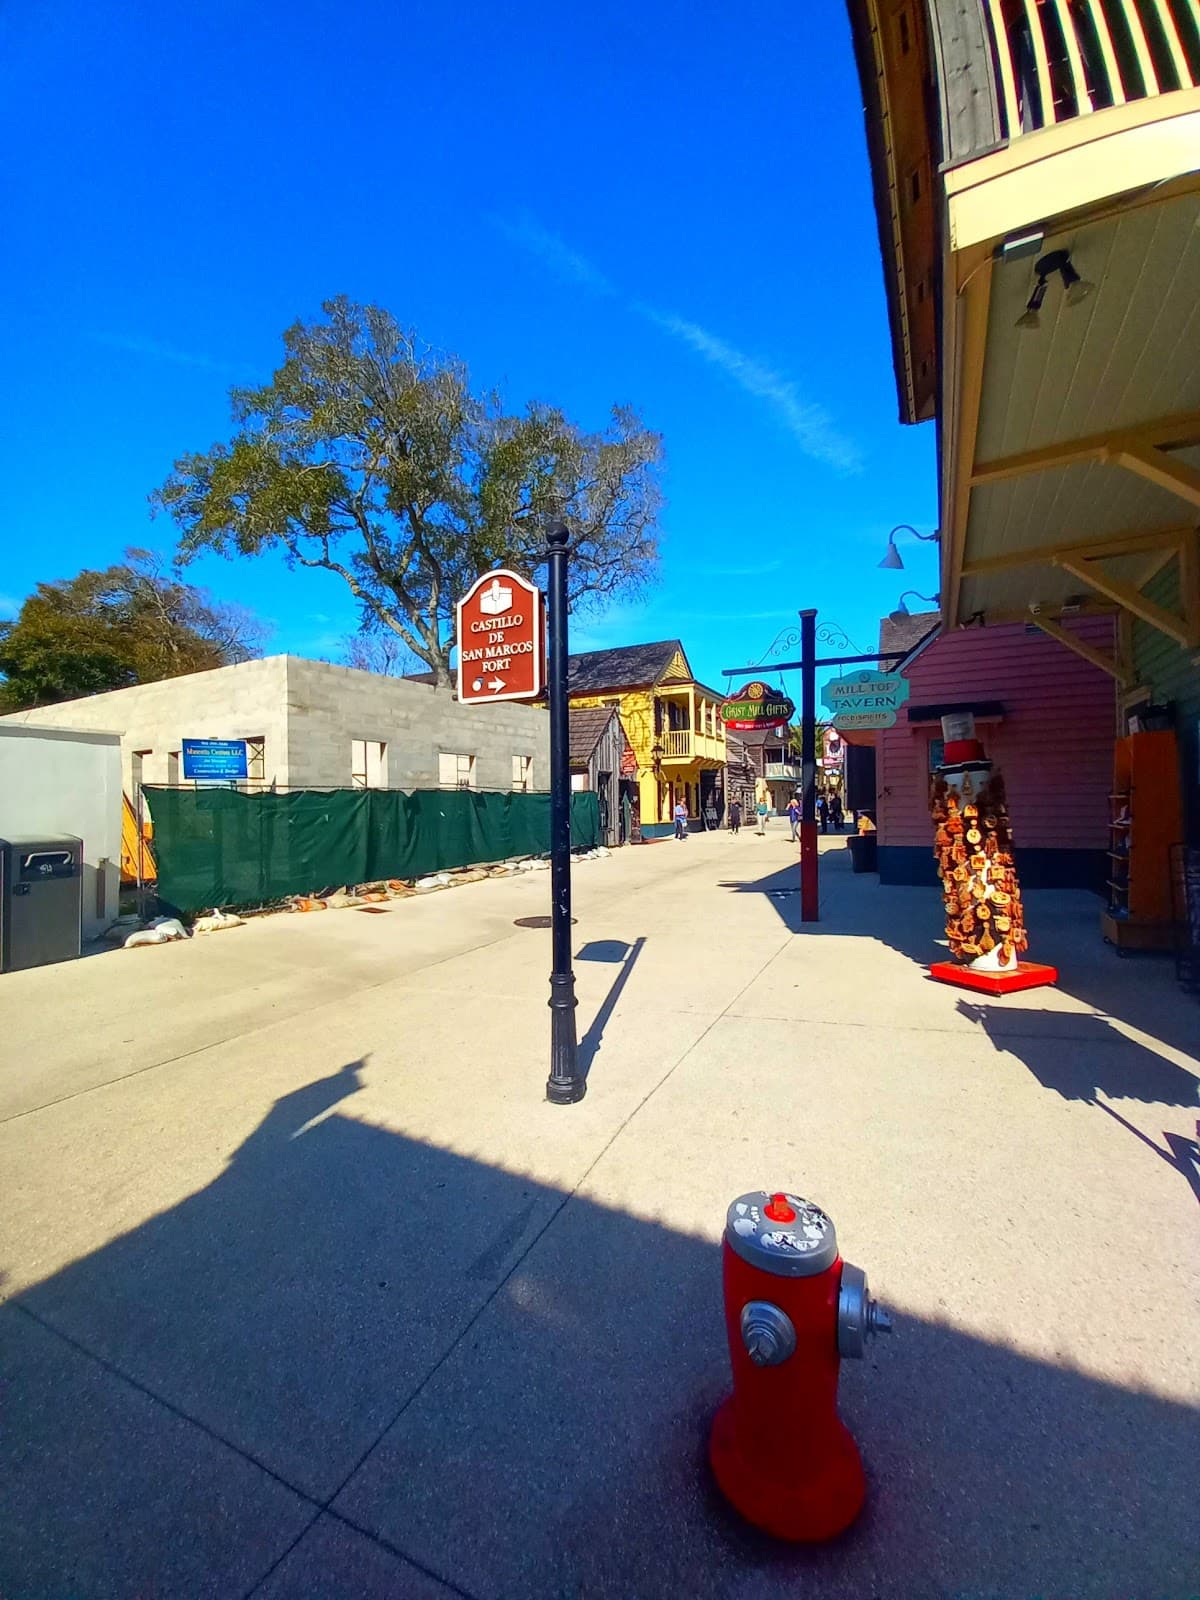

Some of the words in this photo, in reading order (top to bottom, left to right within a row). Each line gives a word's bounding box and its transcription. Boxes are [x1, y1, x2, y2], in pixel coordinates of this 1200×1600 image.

[471, 615, 523, 632] CASTILLO
[489, 632, 504, 643] DE
[463, 648, 483, 661] SAN
[485, 641, 533, 658] MARCOS
[482, 659, 511, 672] FORT
[835, 684, 865, 694] MILL
[870, 681, 892, 691] TOP
[832, 696, 897, 709] TAVERN
[748, 704, 765, 716] MILL
[766, 703, 788, 716] GIFTS
